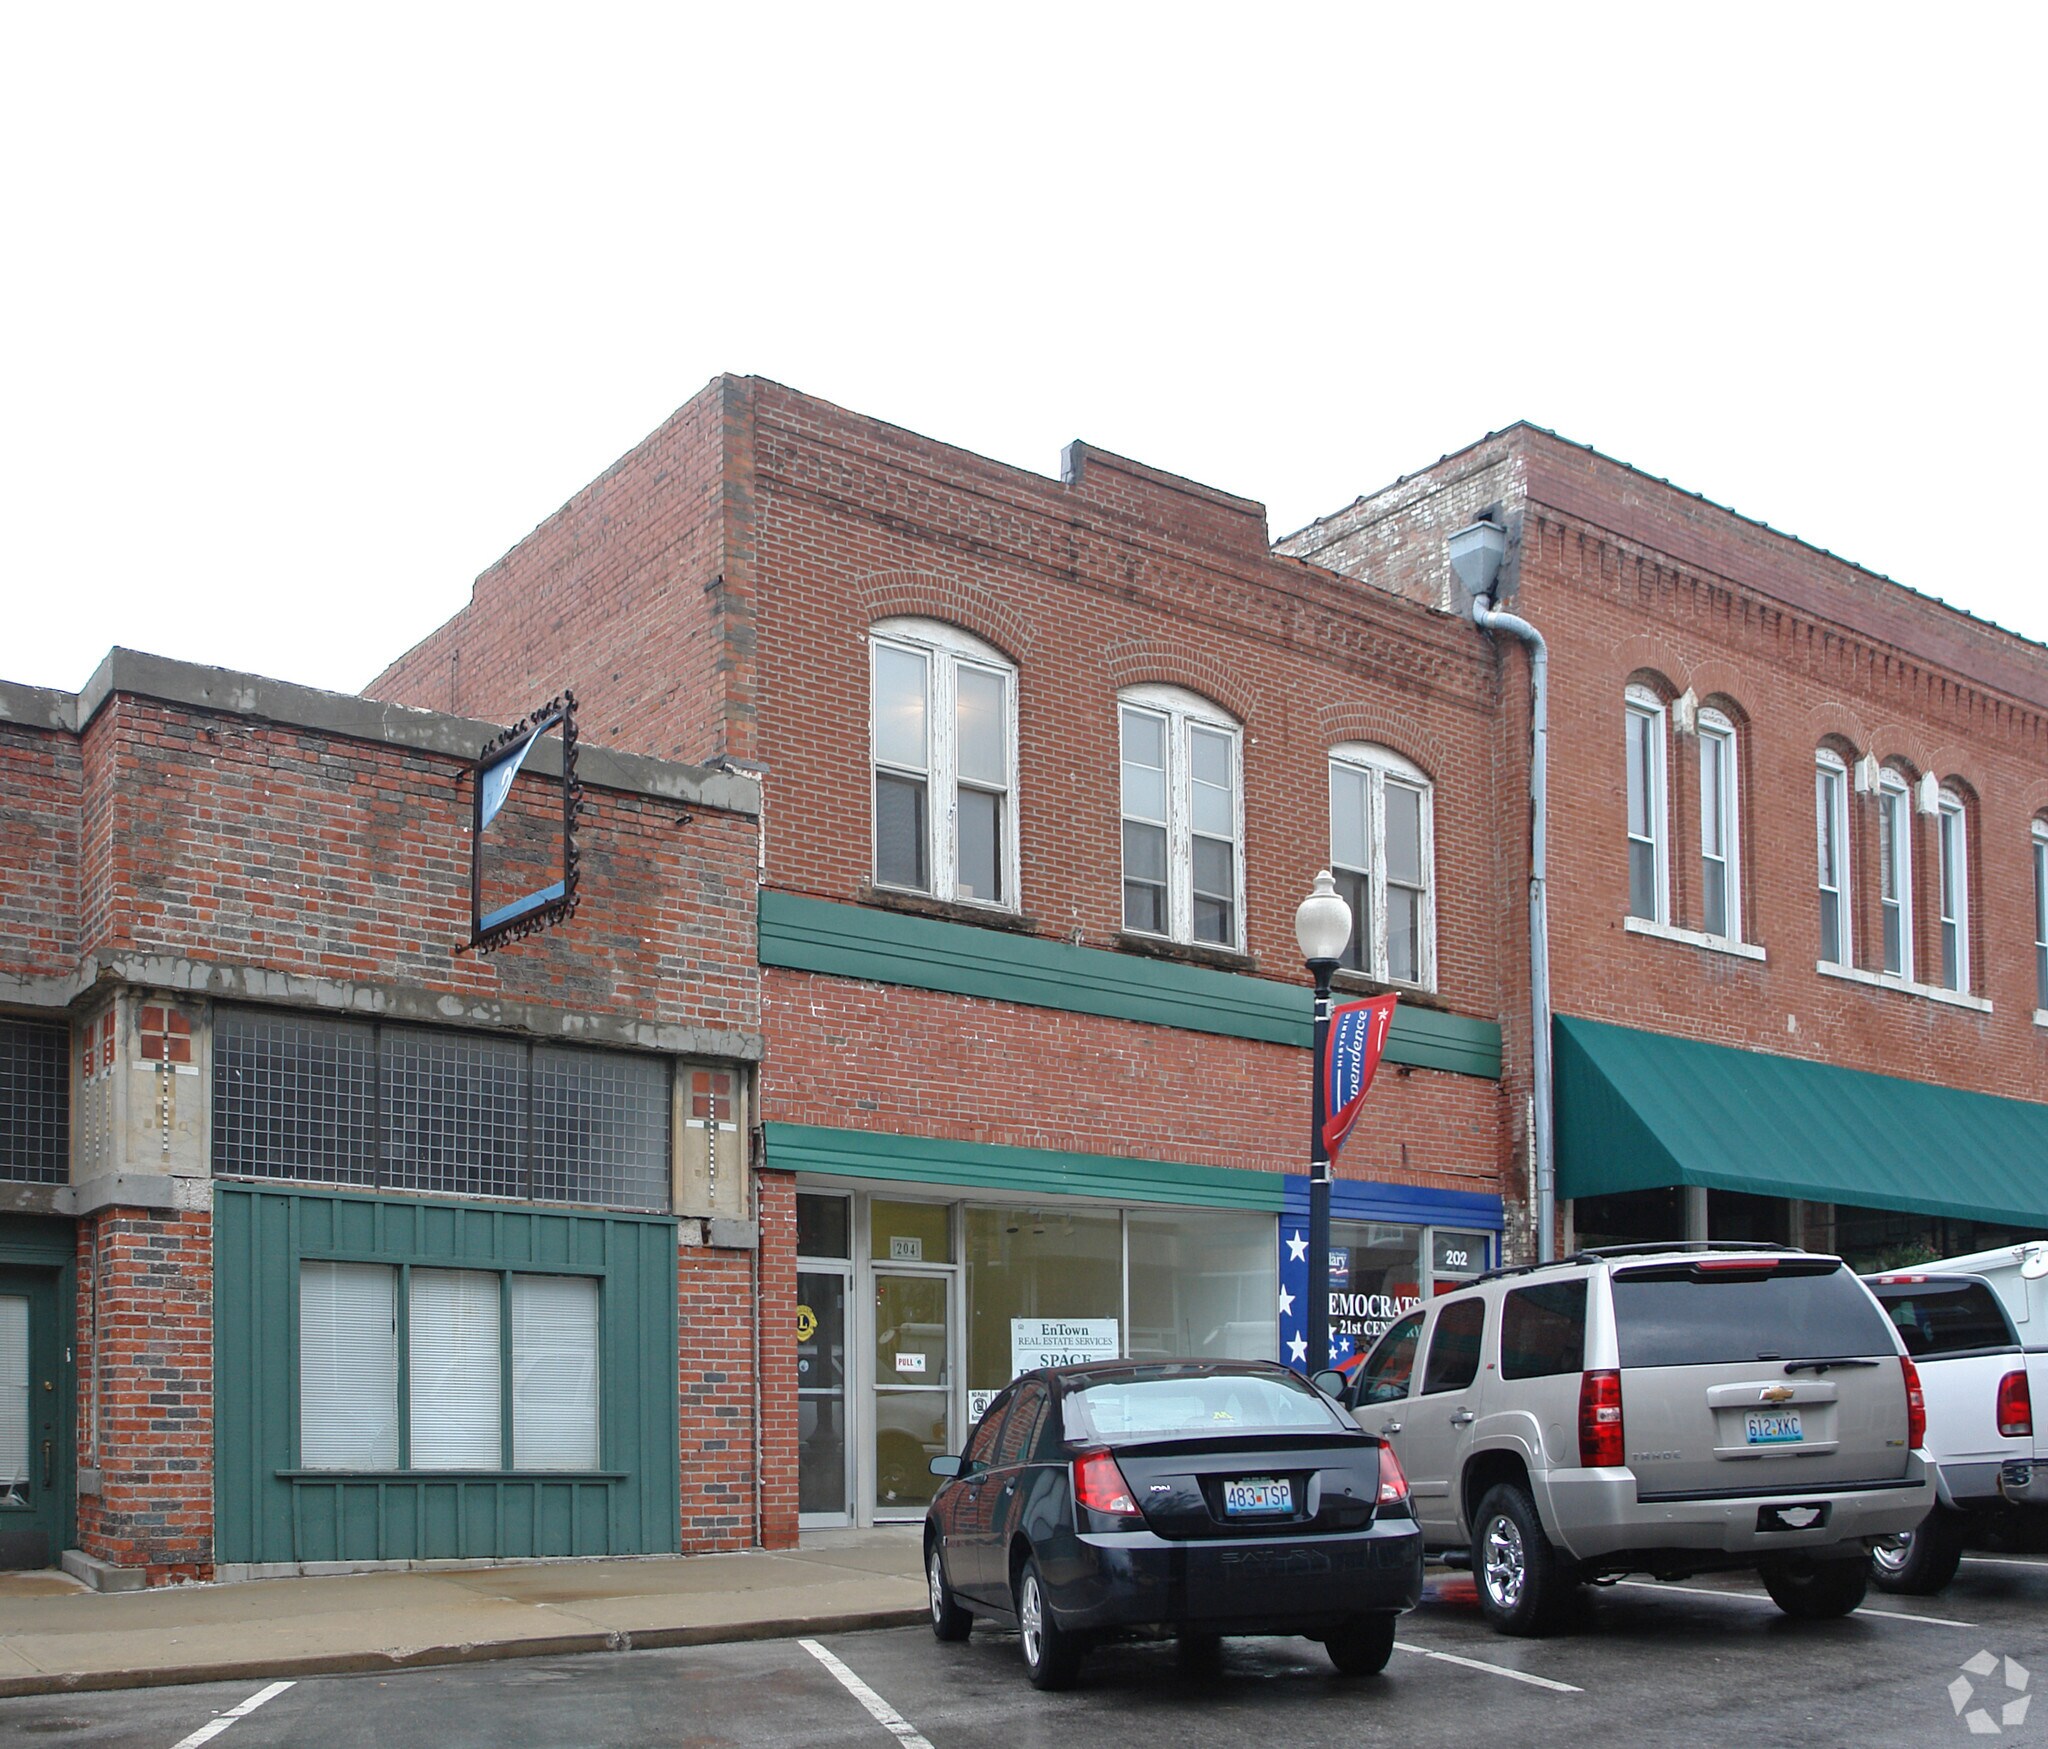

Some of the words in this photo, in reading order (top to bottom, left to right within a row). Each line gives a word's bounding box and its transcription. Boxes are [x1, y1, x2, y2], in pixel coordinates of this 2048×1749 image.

[1337, 1013, 1351, 1067] HISTORIC
[896, 1242, 915, 1255] 204
[1446, 1249, 1467, 1266] 202
[1041, 1323, 1089, 1336] EnTown
[1339, 1319, 1362, 1335] 21st
[1018, 1337, 1041, 1346] REAL
[1043, 1337, 1074, 1346] ESTATE
[1075, 1337, 1113, 1346] SERVICES
[898, 1358, 913, 1366] PULL
[1749, 1418, 1772, 1436] 612
[1776, 1417, 1800, 1435] XKC
[1228, 1487, 1256, 1507] 483
[1259, 1485, 1289, 1506] TSP
